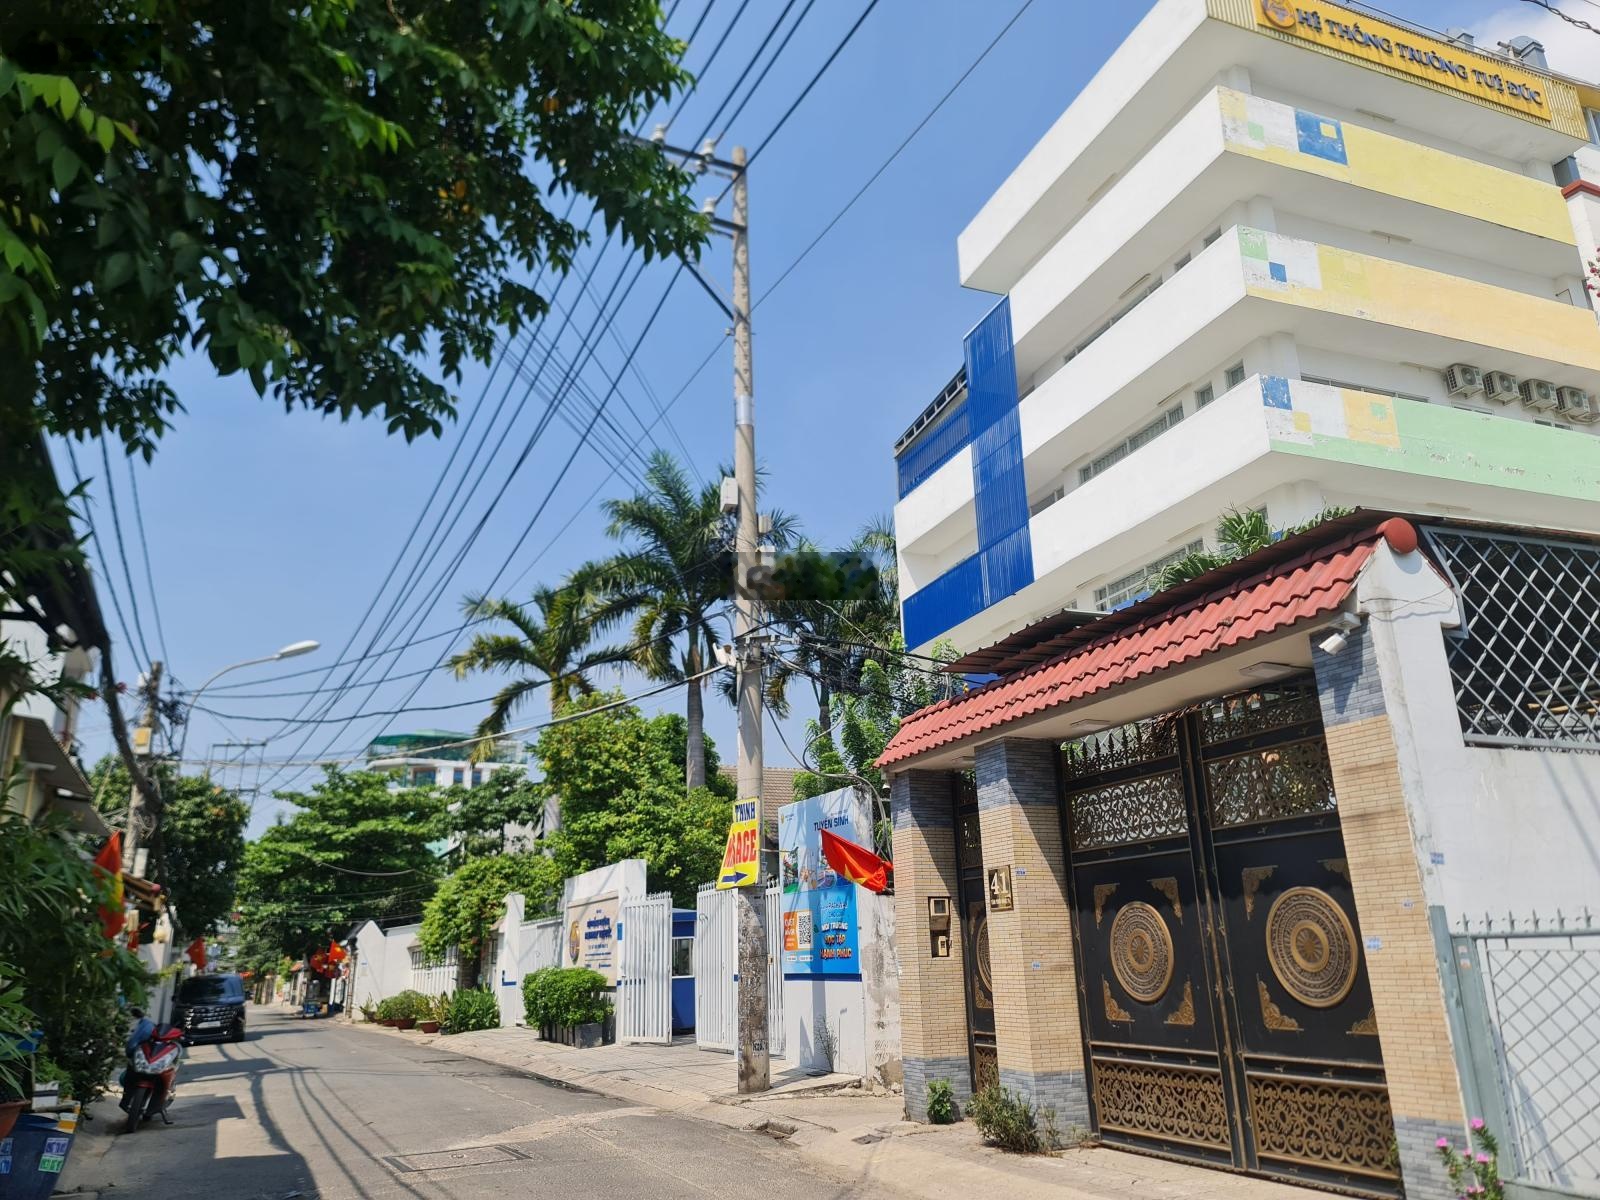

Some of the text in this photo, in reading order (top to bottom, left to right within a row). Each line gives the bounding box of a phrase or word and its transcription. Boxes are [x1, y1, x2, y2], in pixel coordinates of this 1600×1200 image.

[1296, 8, 1322, 32] HỆ
[1325, 18, 1393, 54] THỐNG
[834, 815, 849, 827] SINH
[991, 871, 1009, 895] 41
